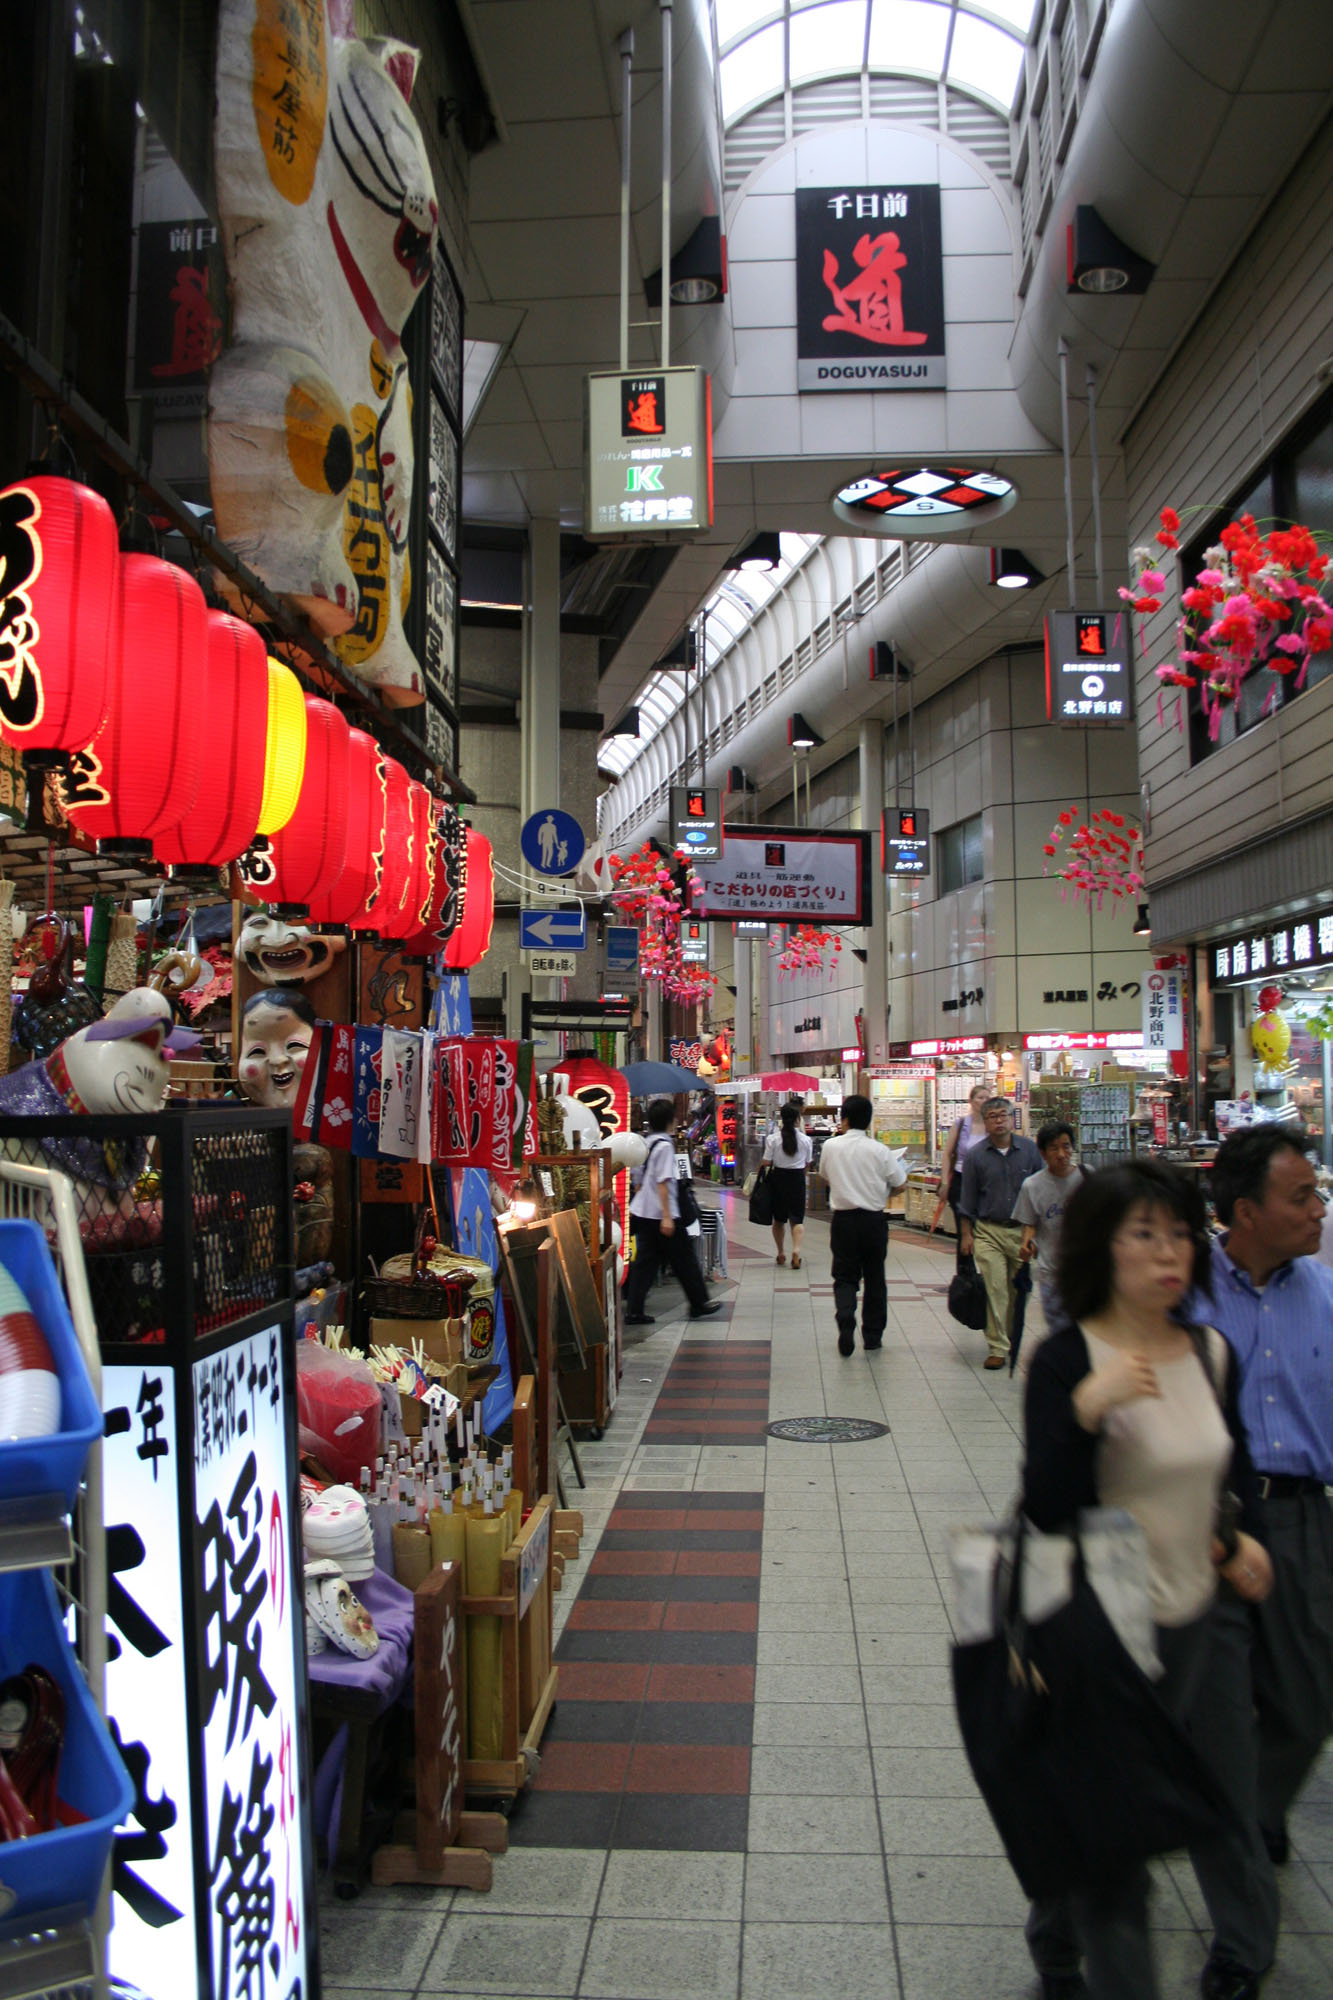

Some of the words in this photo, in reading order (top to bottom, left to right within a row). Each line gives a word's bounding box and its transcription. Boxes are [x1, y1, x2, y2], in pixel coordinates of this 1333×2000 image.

[827, 193, 908, 219] 千日前
[823, 231, 928, 346] 道
[818, 365, 928, 379] DOGUYASUJI
[916, 502, 934, 511] S
[1063, 701, 1122, 714] 北野商店
[532, 958, 575, 972] 自転車を除く
[1150, 991, 1165, 1047] 北野商店
[195, 1329, 280, 1468] 業昭和二十一年
